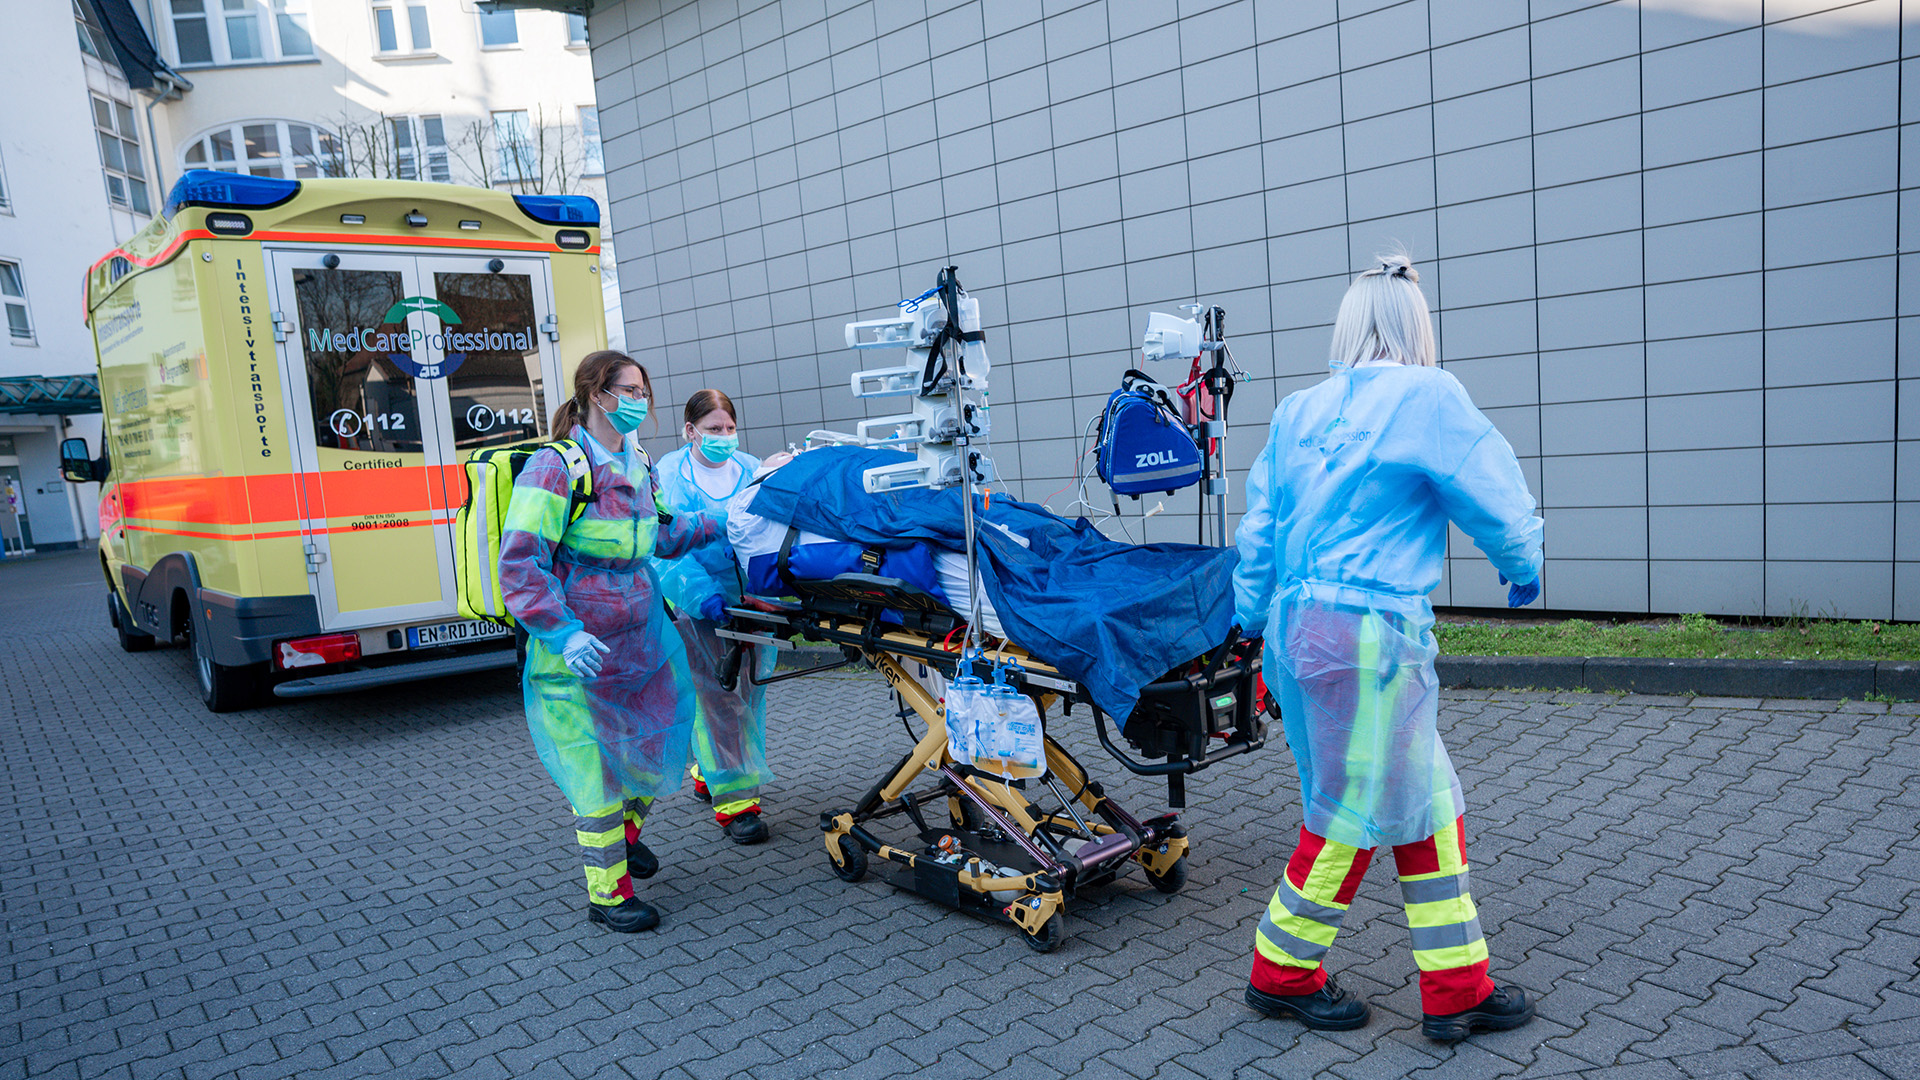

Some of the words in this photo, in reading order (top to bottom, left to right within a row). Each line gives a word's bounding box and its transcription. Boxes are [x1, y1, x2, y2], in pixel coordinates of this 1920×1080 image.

[308, 326, 533, 352] MedCareProfessional
[236, 258, 272, 458] Intensivtransporte
[363, 413, 406, 431] 112
[496, 408, 534, 425] 112
[343, 458, 403, 470] Certified
[1135, 449, 1179, 468] ZOLL
[351, 518, 410, 531] 9001:2008
[418, 627, 439, 644] EN
[448, 622, 468, 640] RD
